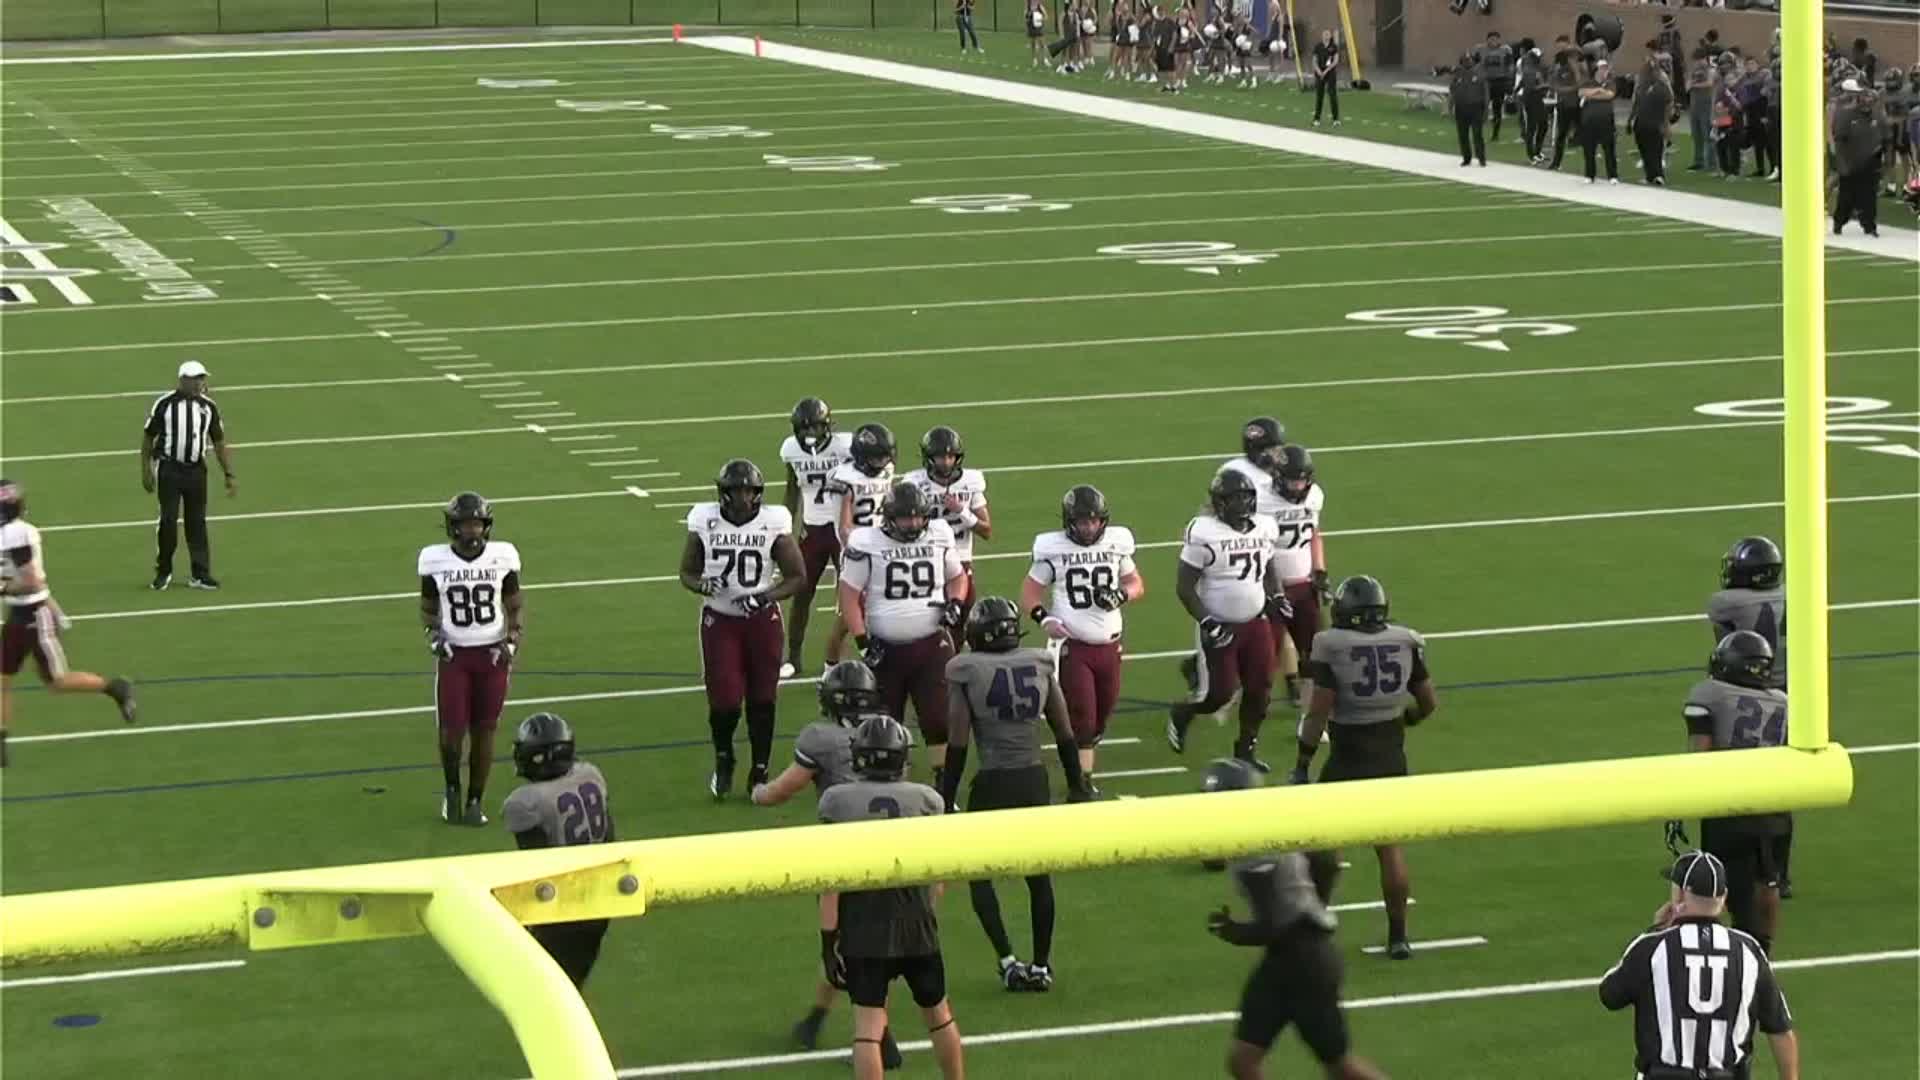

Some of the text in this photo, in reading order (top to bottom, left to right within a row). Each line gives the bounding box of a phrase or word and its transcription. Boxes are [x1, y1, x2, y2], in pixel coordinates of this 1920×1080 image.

[806, 473, 827, 505] 7
[708, 533, 767, 548] PEARLAND
[880, 545, 935, 561] PEARLAND
[442, 568, 498, 583] PEARLAND
[711, 548, 763, 589] 70
[884, 560, 936, 600] 69
[1229, 551, 1262, 583] 71
[446, 583, 496, 628] 88
[1350, 644, 1402, 697] 35
[985, 664, 1041, 721] 45
[556, 781, 607, 845] 28
[1684, 954, 1729, 1014] U
